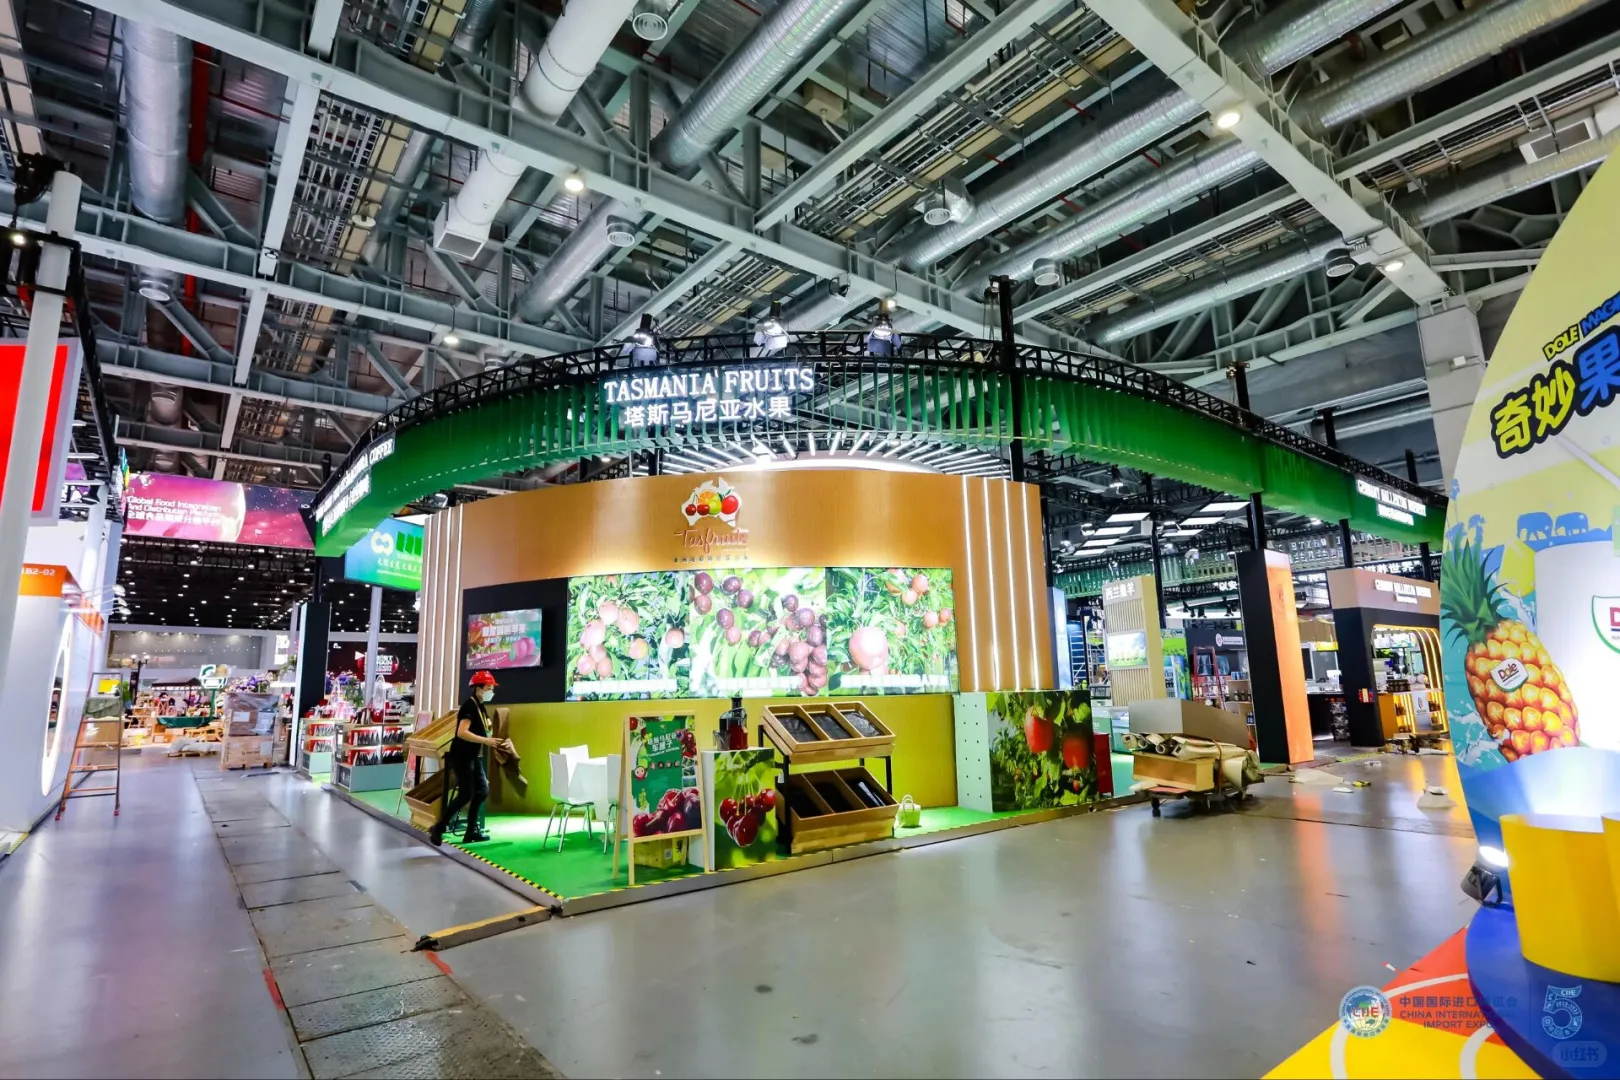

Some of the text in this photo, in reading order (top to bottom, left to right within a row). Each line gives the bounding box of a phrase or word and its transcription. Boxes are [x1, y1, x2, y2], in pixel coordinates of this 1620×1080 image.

[1542, 324, 1580, 362] DOLE
[724, 368, 814, 393] FRUITS
[1492, 329, 1620, 456] 奇妙果
[624, 396, 792, 428] 塔斯马尼亚水果
[127, 496, 153, 504] Global
[155, 499, 175, 507] Food
[128, 503, 143, 511] And
[1497, 662, 1519, 680] Dole
